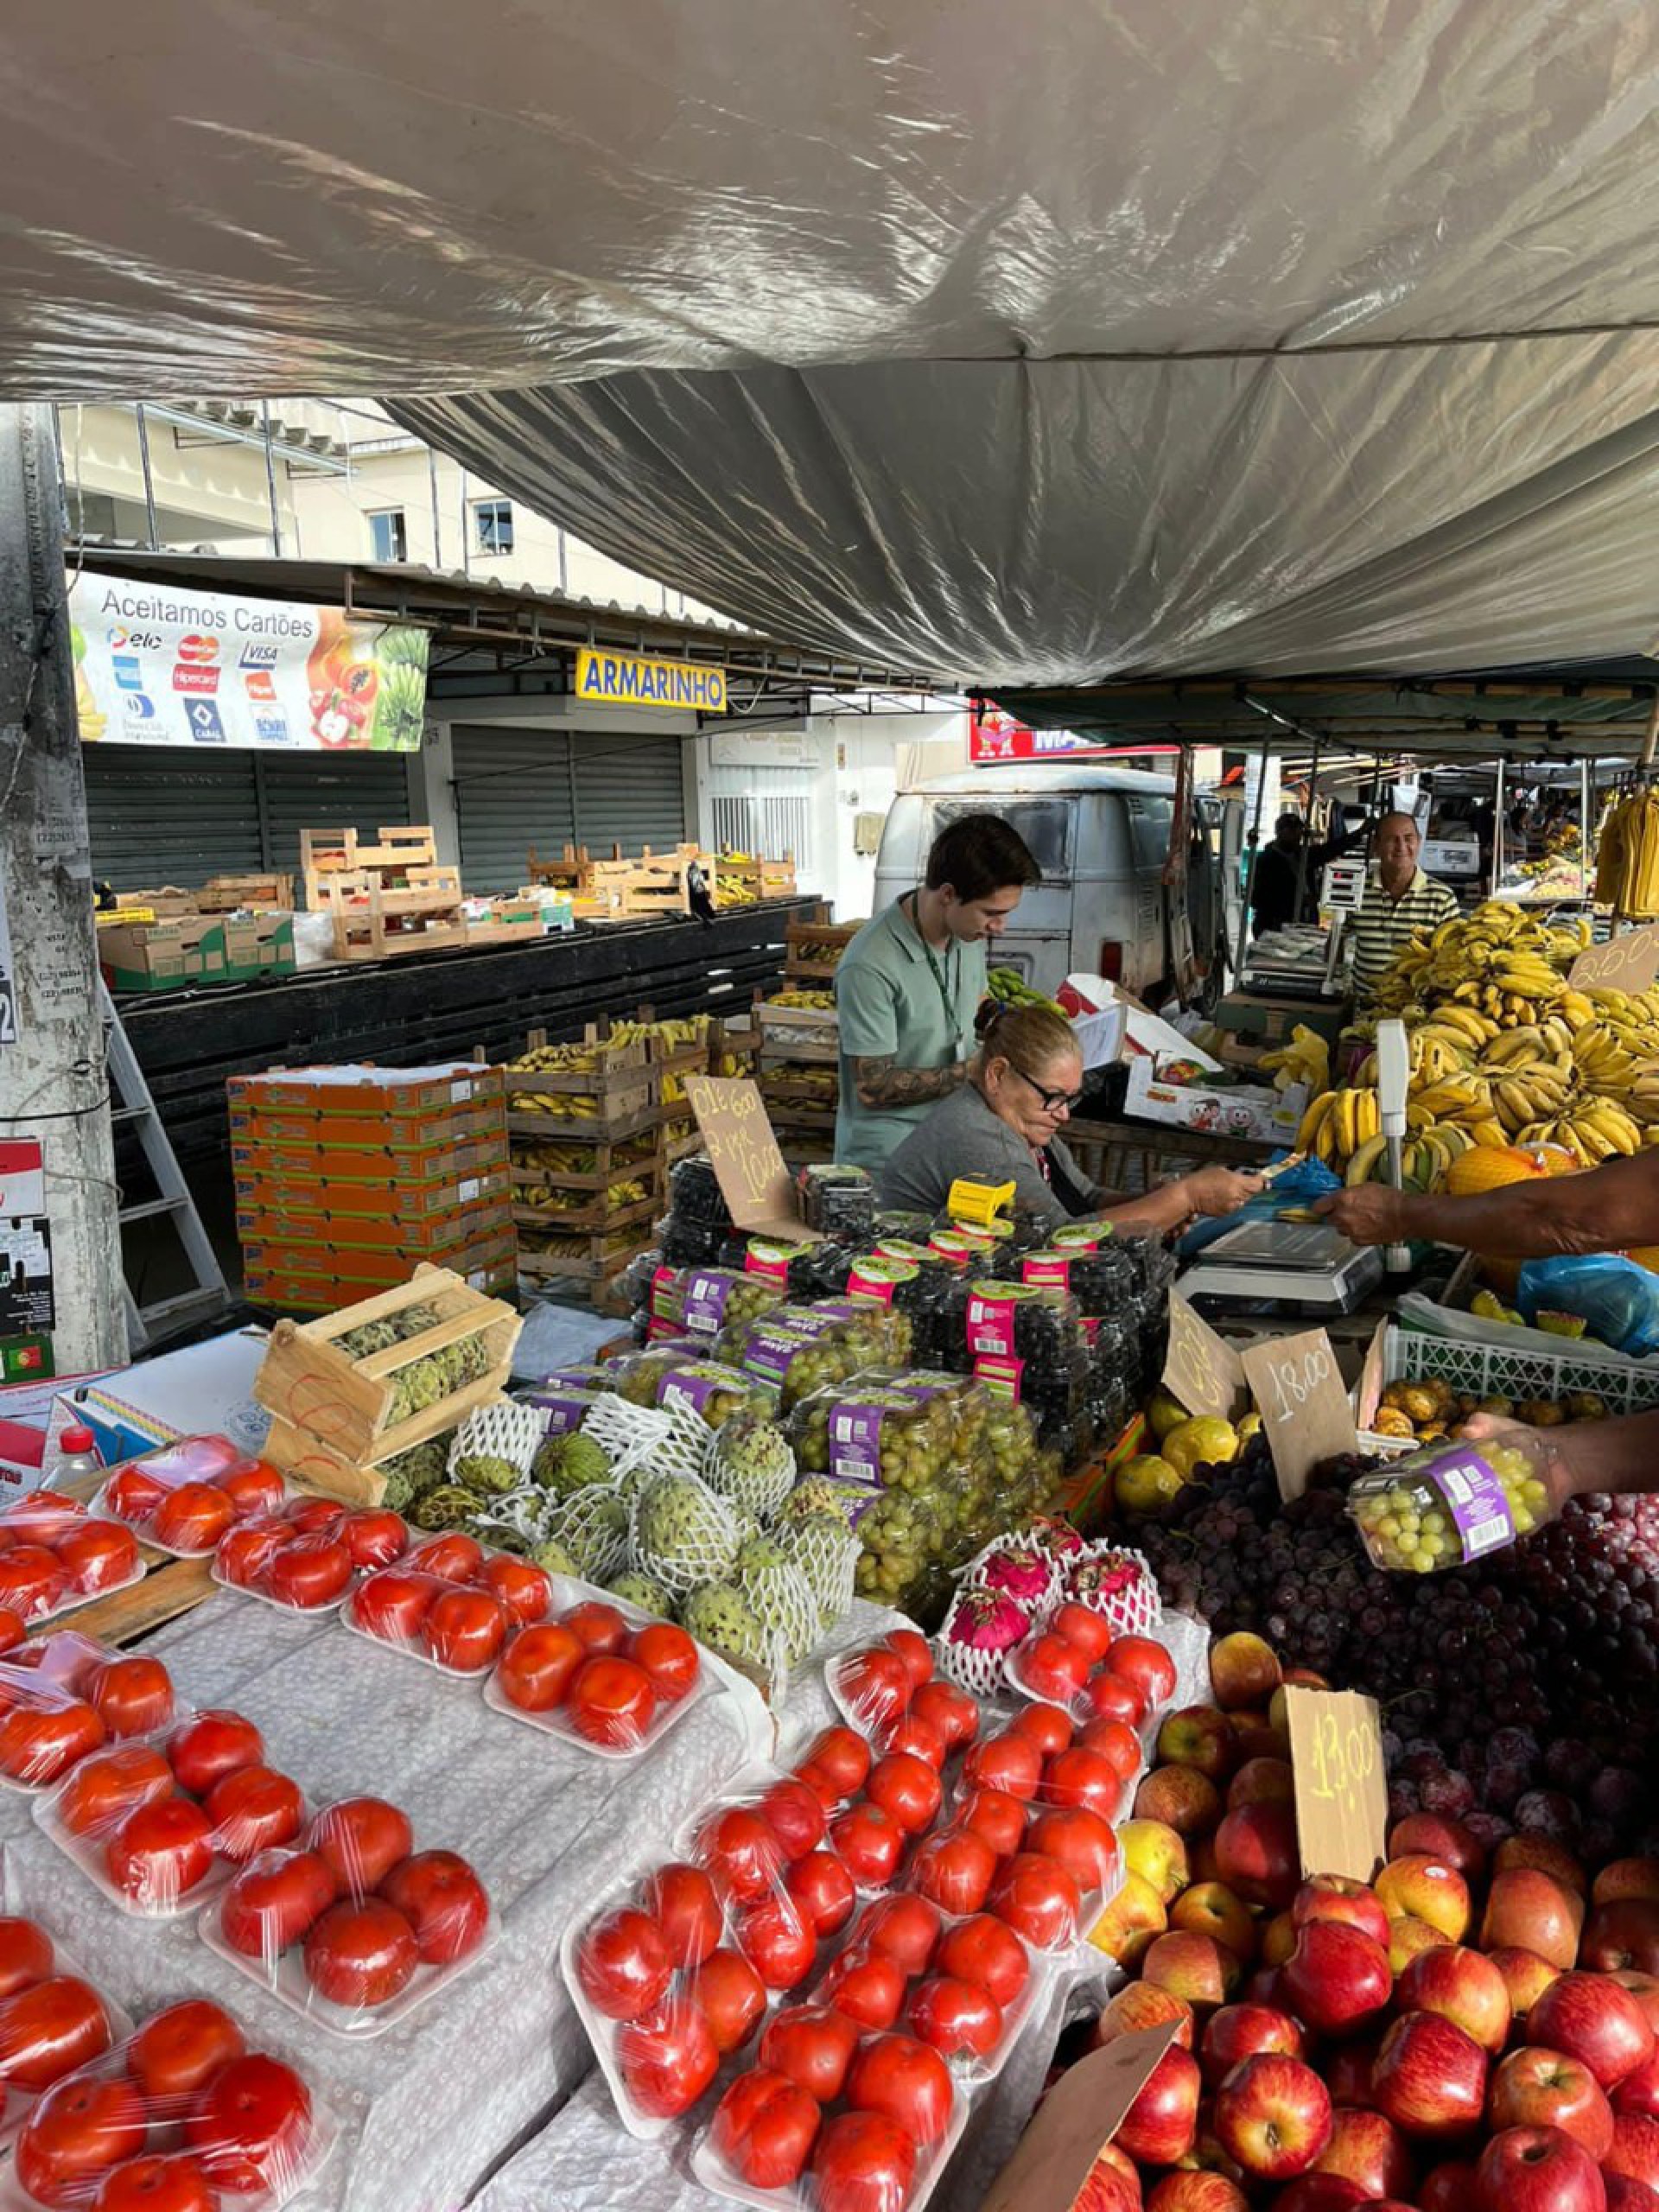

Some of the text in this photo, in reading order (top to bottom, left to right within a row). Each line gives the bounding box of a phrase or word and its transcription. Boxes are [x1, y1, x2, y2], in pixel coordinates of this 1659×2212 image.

[100, 588, 315, 639] Aceitamos Cartões
[251, 645, 277, 660] VISA
[583, 658, 722, 707] ARMARINHO
